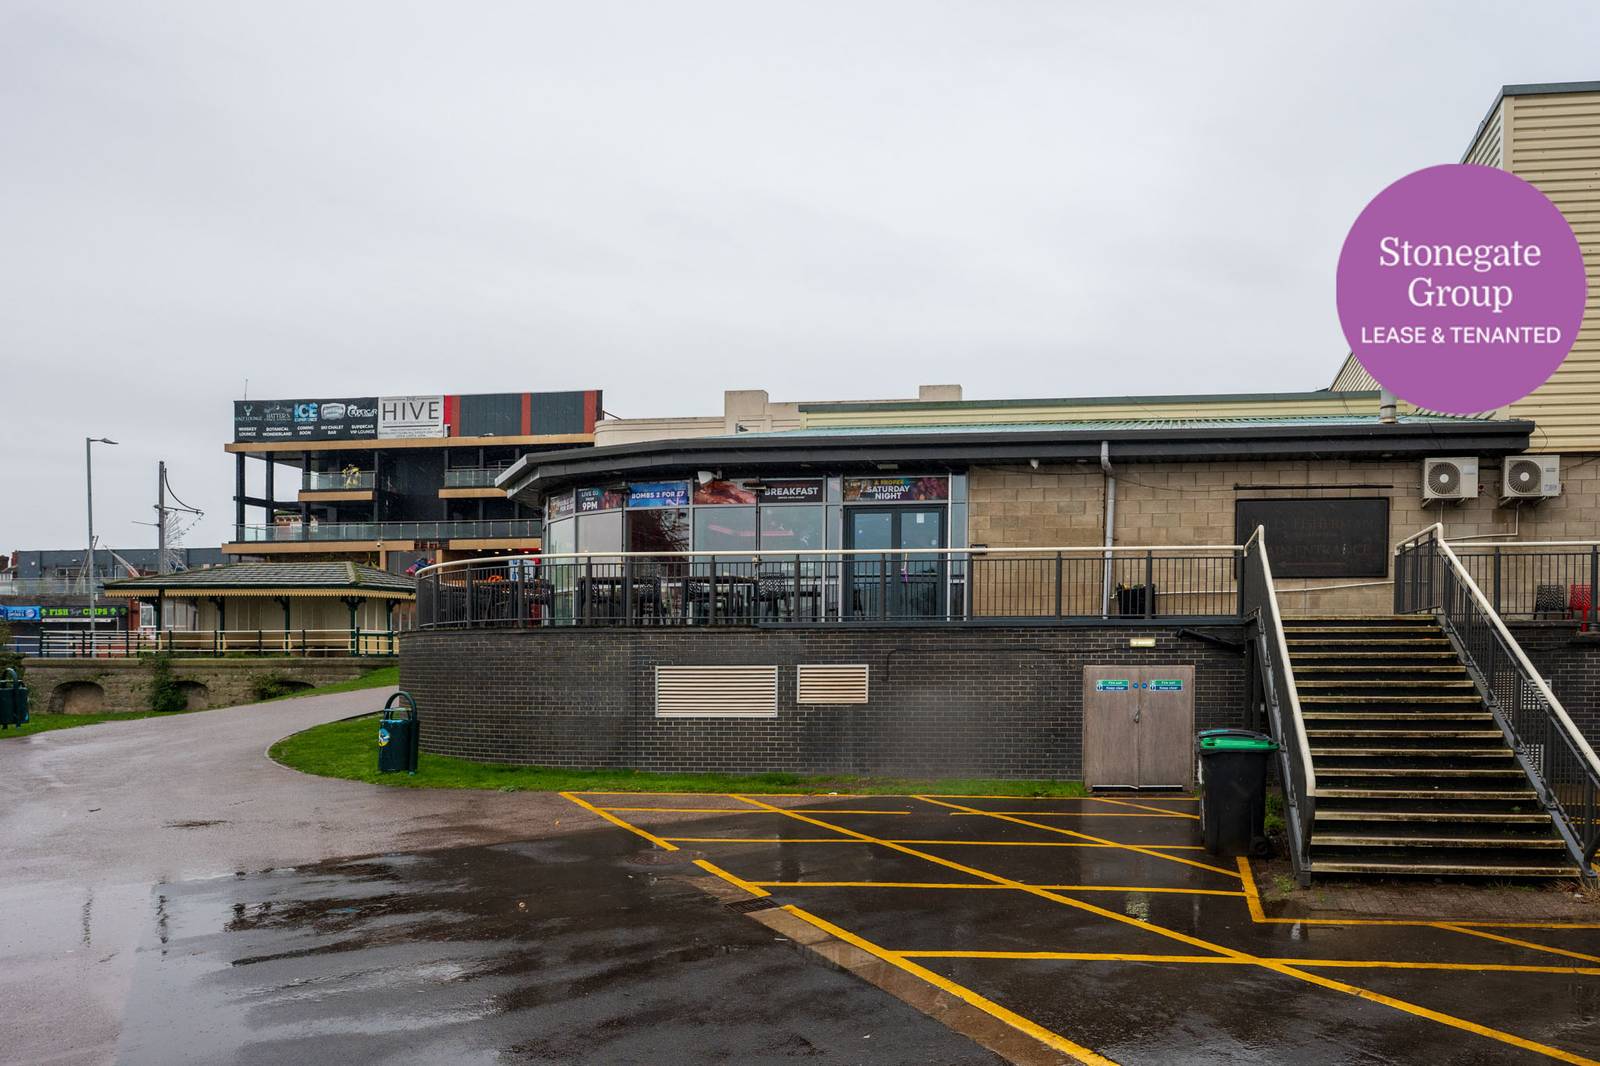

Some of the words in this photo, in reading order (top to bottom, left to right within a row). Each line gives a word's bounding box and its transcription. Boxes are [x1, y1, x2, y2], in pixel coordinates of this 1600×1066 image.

[294, 402, 318, 417] ICE
[382, 401, 439, 420] HIVE
[764, 487, 819, 496] BREAKFAST
[867, 485, 910, 493] SATURDAY
[662, 490, 676, 498] FOR
[875, 492, 902, 500] NIGHT
[582, 501, 598, 510] 9PM
[49, 608, 69, 616] FISH
[82, 608, 108, 616] CIPS
